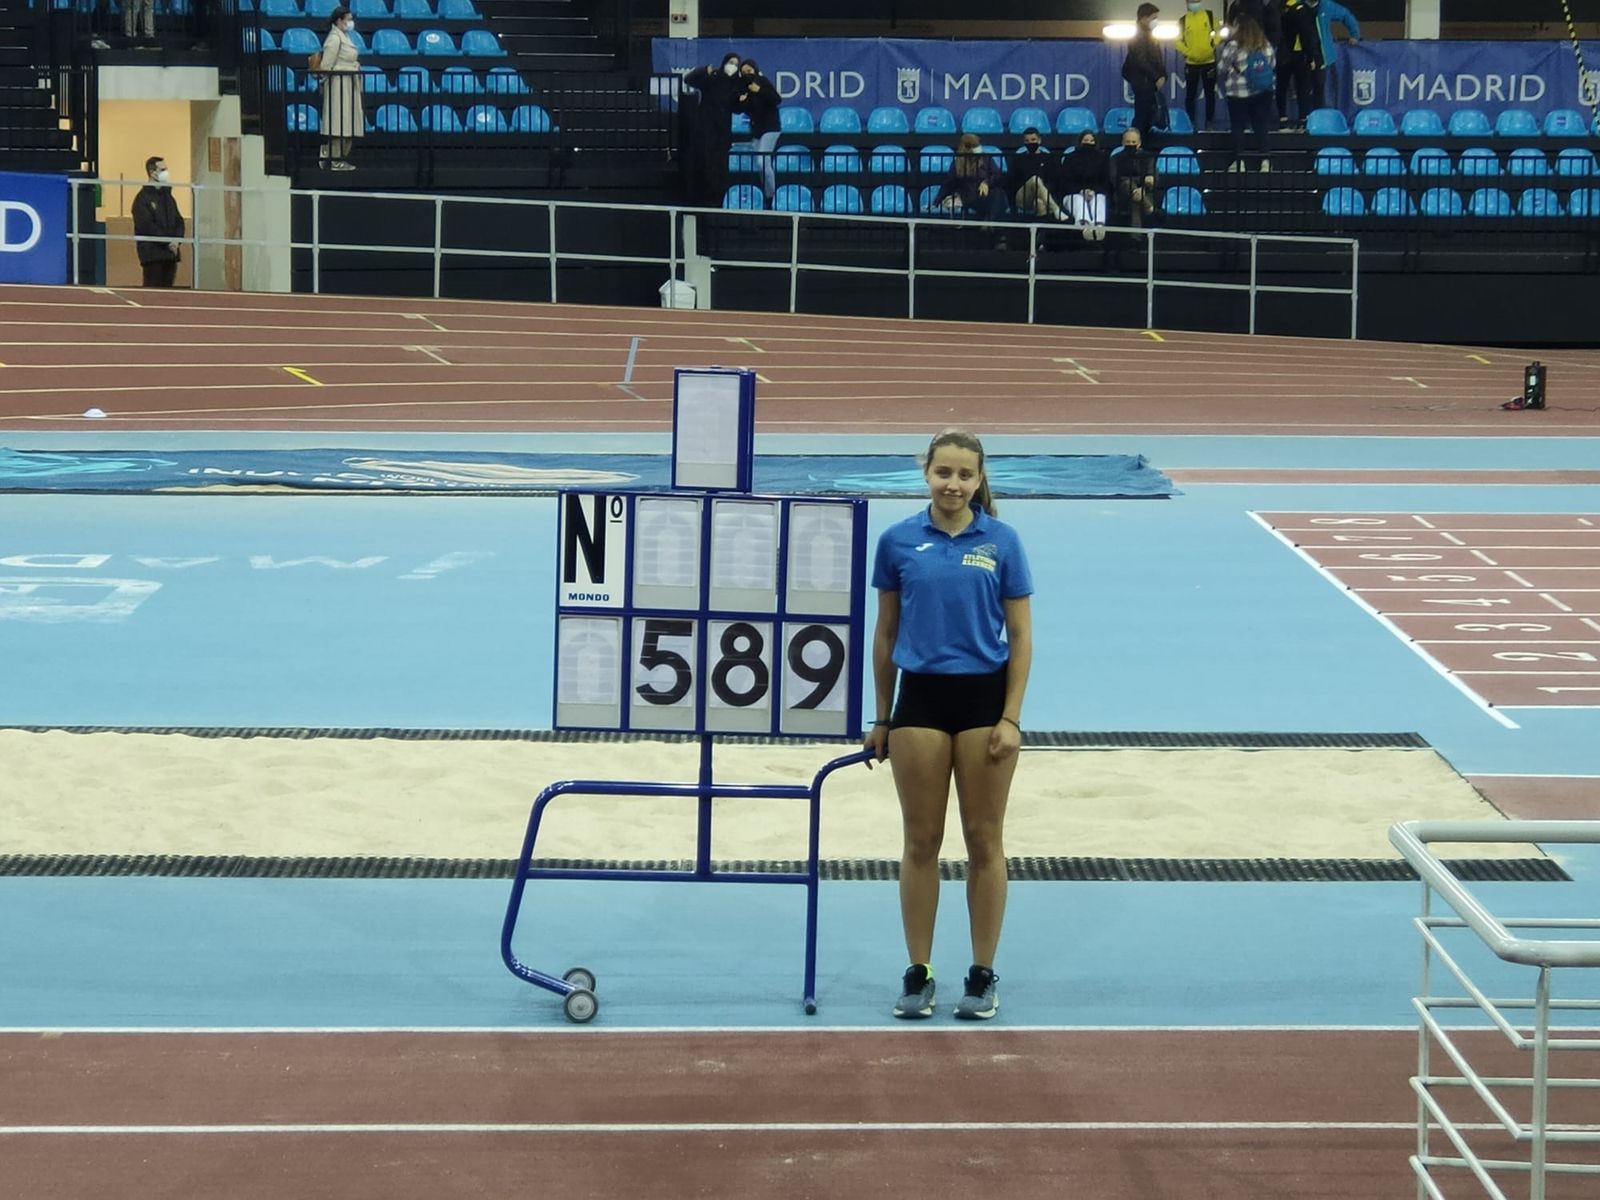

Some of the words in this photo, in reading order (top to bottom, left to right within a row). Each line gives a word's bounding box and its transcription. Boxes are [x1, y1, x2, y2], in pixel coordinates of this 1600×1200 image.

[776, 71, 865, 98] DRID
[944, 72, 1090, 101] MADRID
[1399, 72, 1546, 101] MADRID
[0, 200, 42, 252] D
[1309, 517, 1387, 526] 8
[1358, 553, 1443, 561] 6
[1386, 574, 1477, 582] 5
[568, 592, 610, 602] MONDO
[1421, 597, 1511, 607] 4
[1453, 622, 1552, 632] 3
[1491, 651, 1598, 662] 2
